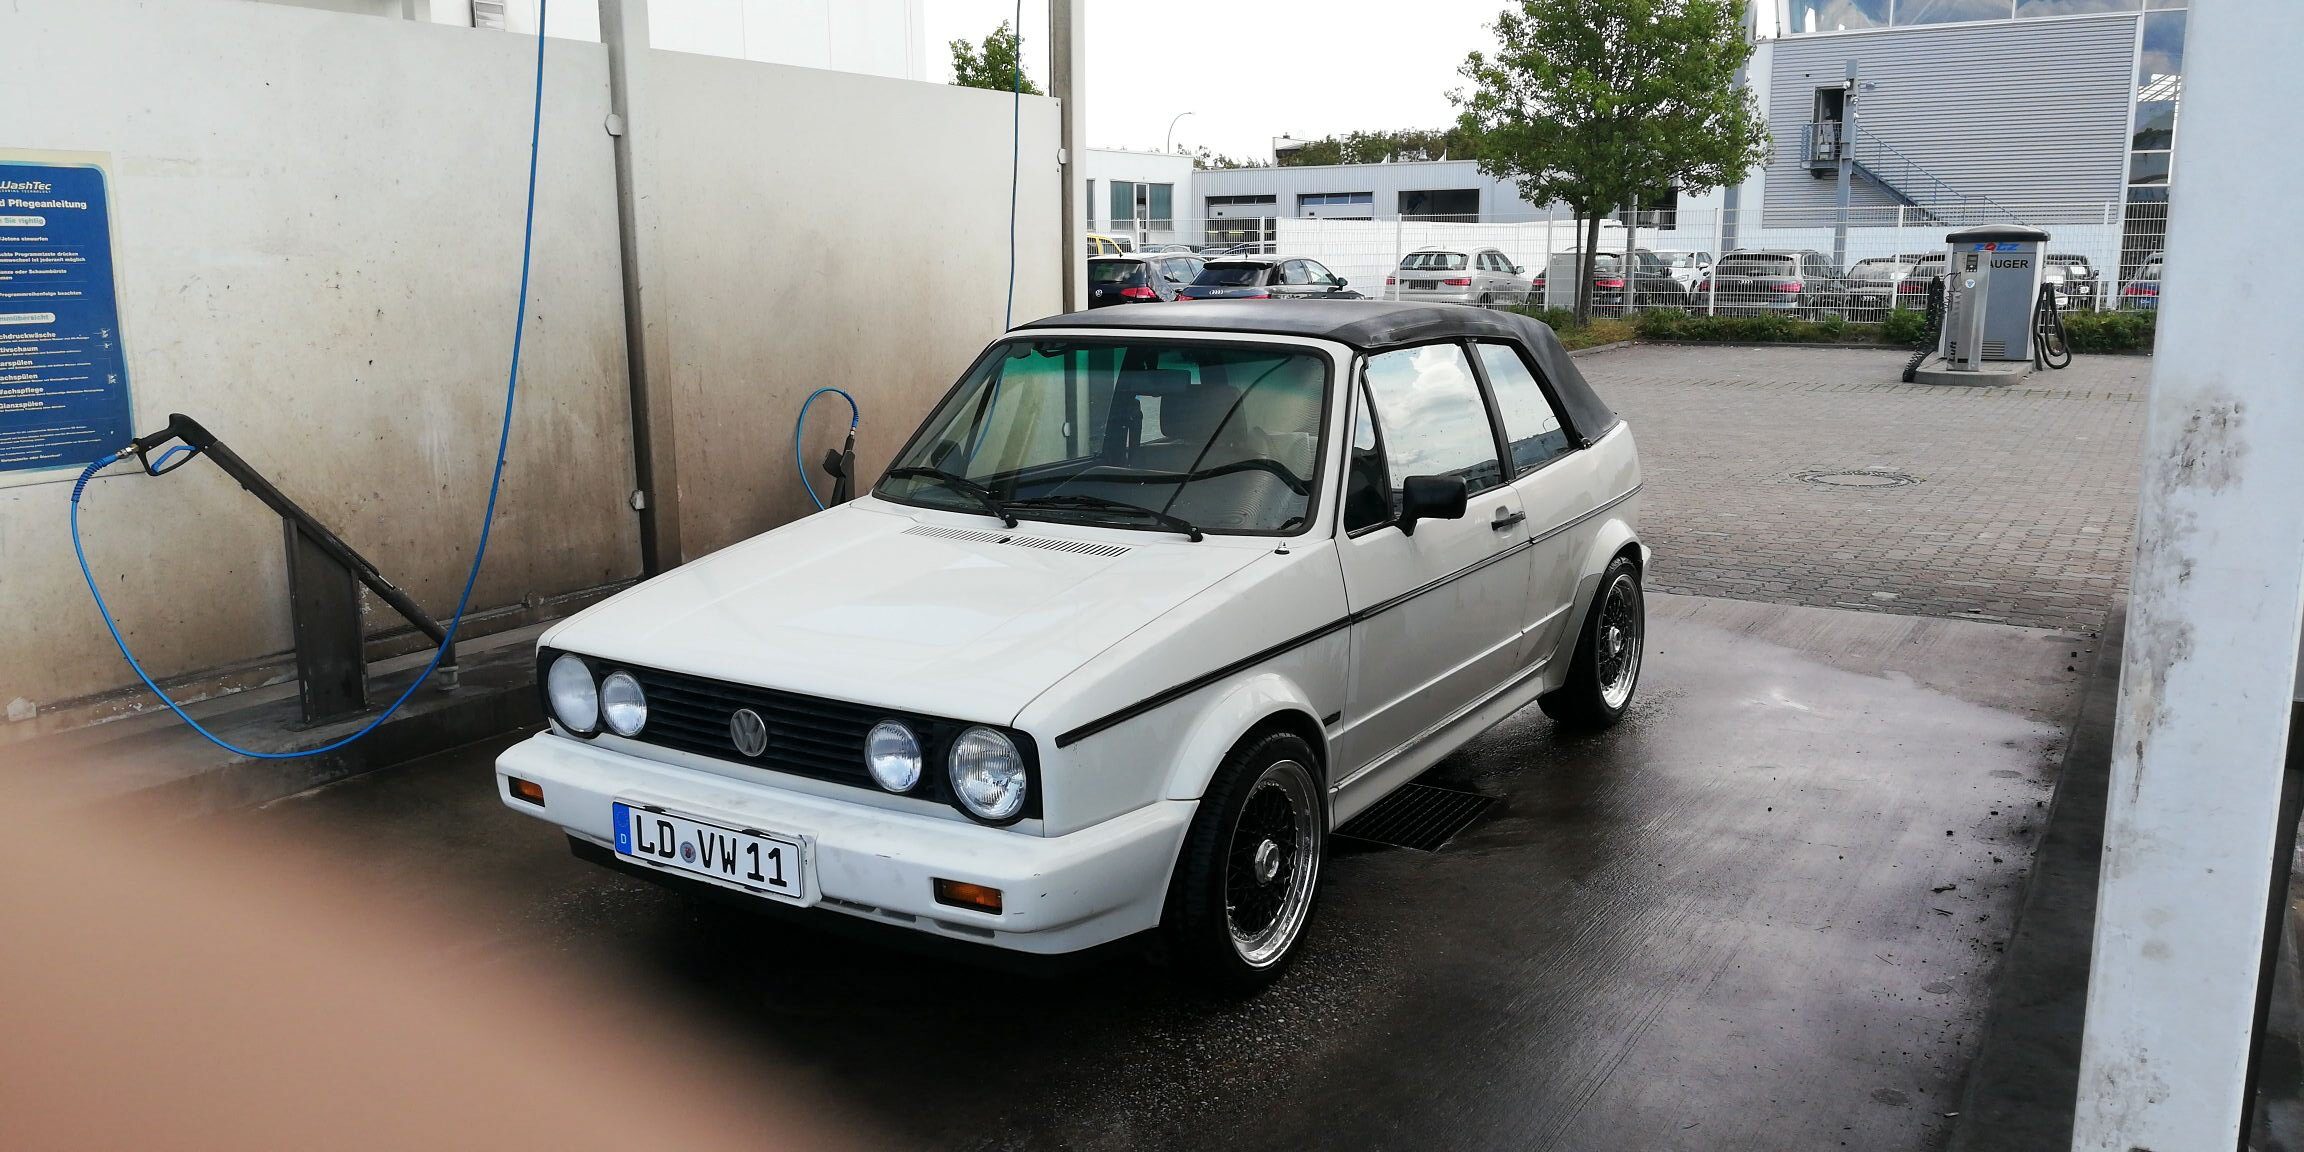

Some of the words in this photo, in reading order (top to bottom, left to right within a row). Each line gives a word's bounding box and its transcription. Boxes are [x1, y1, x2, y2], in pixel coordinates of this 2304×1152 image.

[8, 199, 87, 209] Pflegeanleitung
[1990, 260, 2028, 268] AUGER
[636, 815, 676, 859] LD
[697, 829, 738, 876] VW
[746, 842, 788, 888] 11
